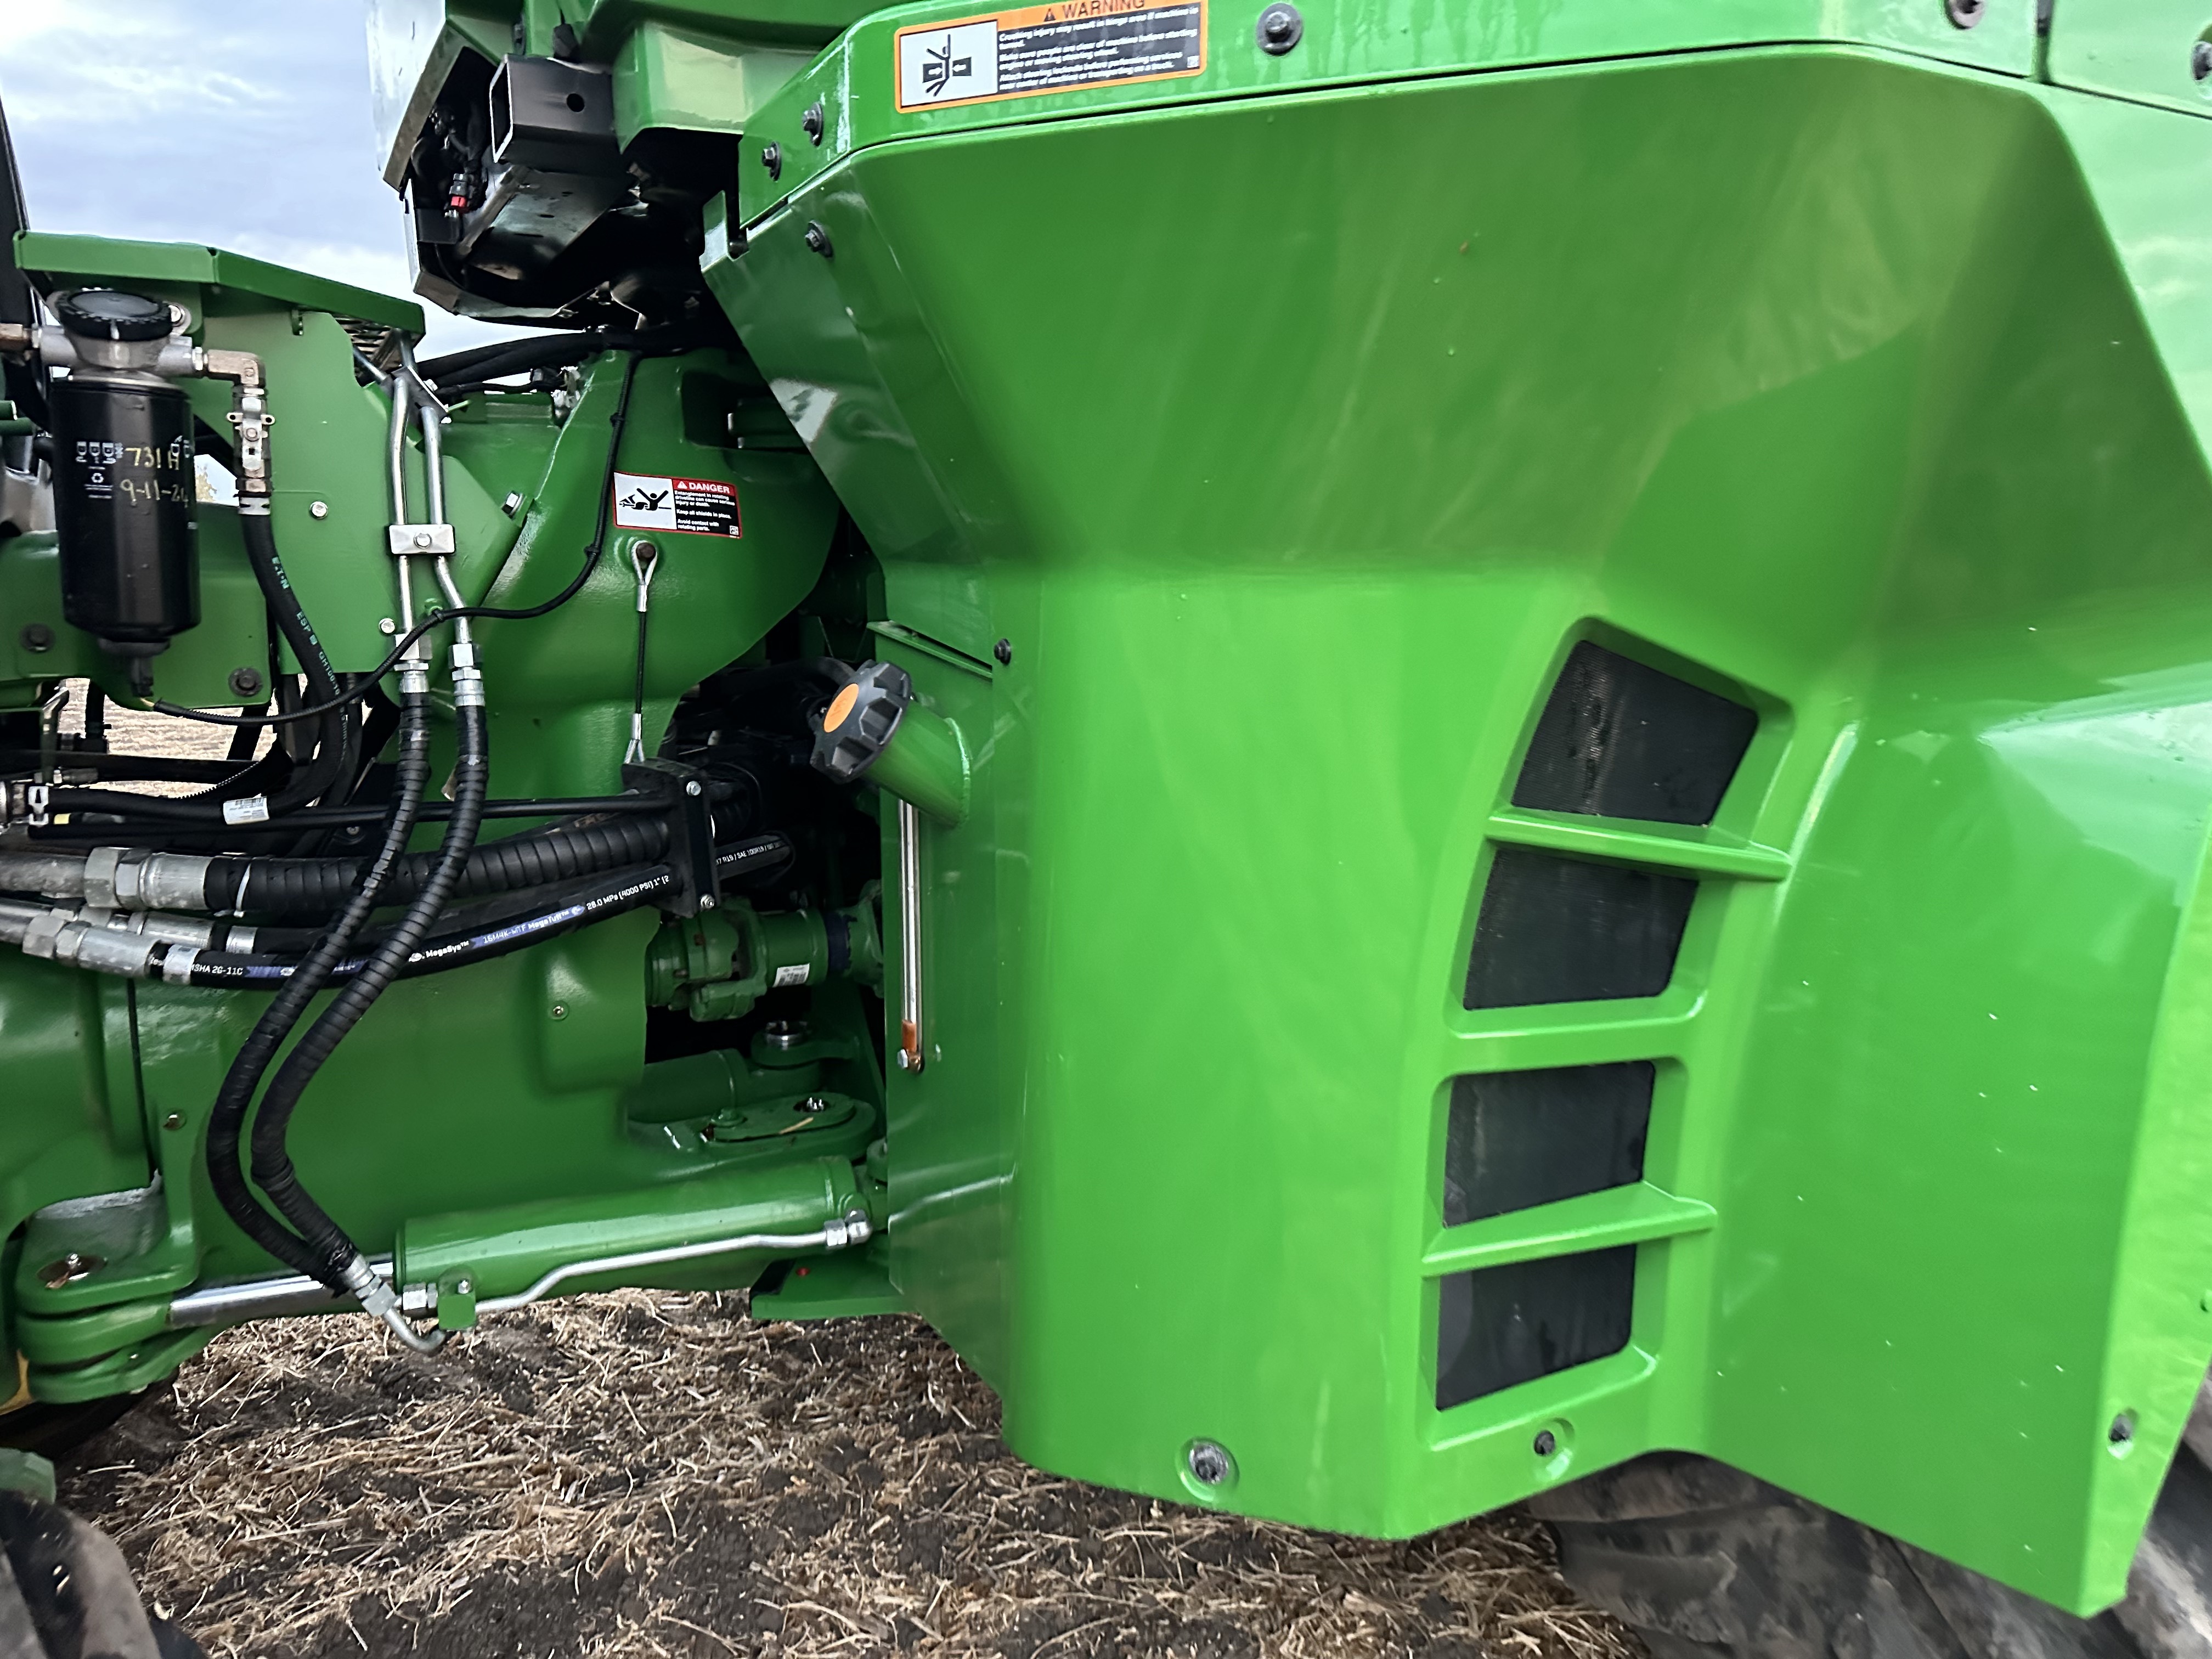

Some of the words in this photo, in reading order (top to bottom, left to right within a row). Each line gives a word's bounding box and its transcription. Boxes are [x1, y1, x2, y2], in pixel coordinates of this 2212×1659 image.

[1063, 0, 1144, 19] WARNING
[125, 446, 161, 469] 731
[689, 482, 730, 494] DANGER
[737, 850, 747, 859] SAE
[586, 898, 603, 911] 28.0
[603, 894, 618, 904] MPa
[618, 885, 639, 900] (4000
[639, 881, 654, 891] PSI)
[212, 966, 244, 975] 2G-11C
